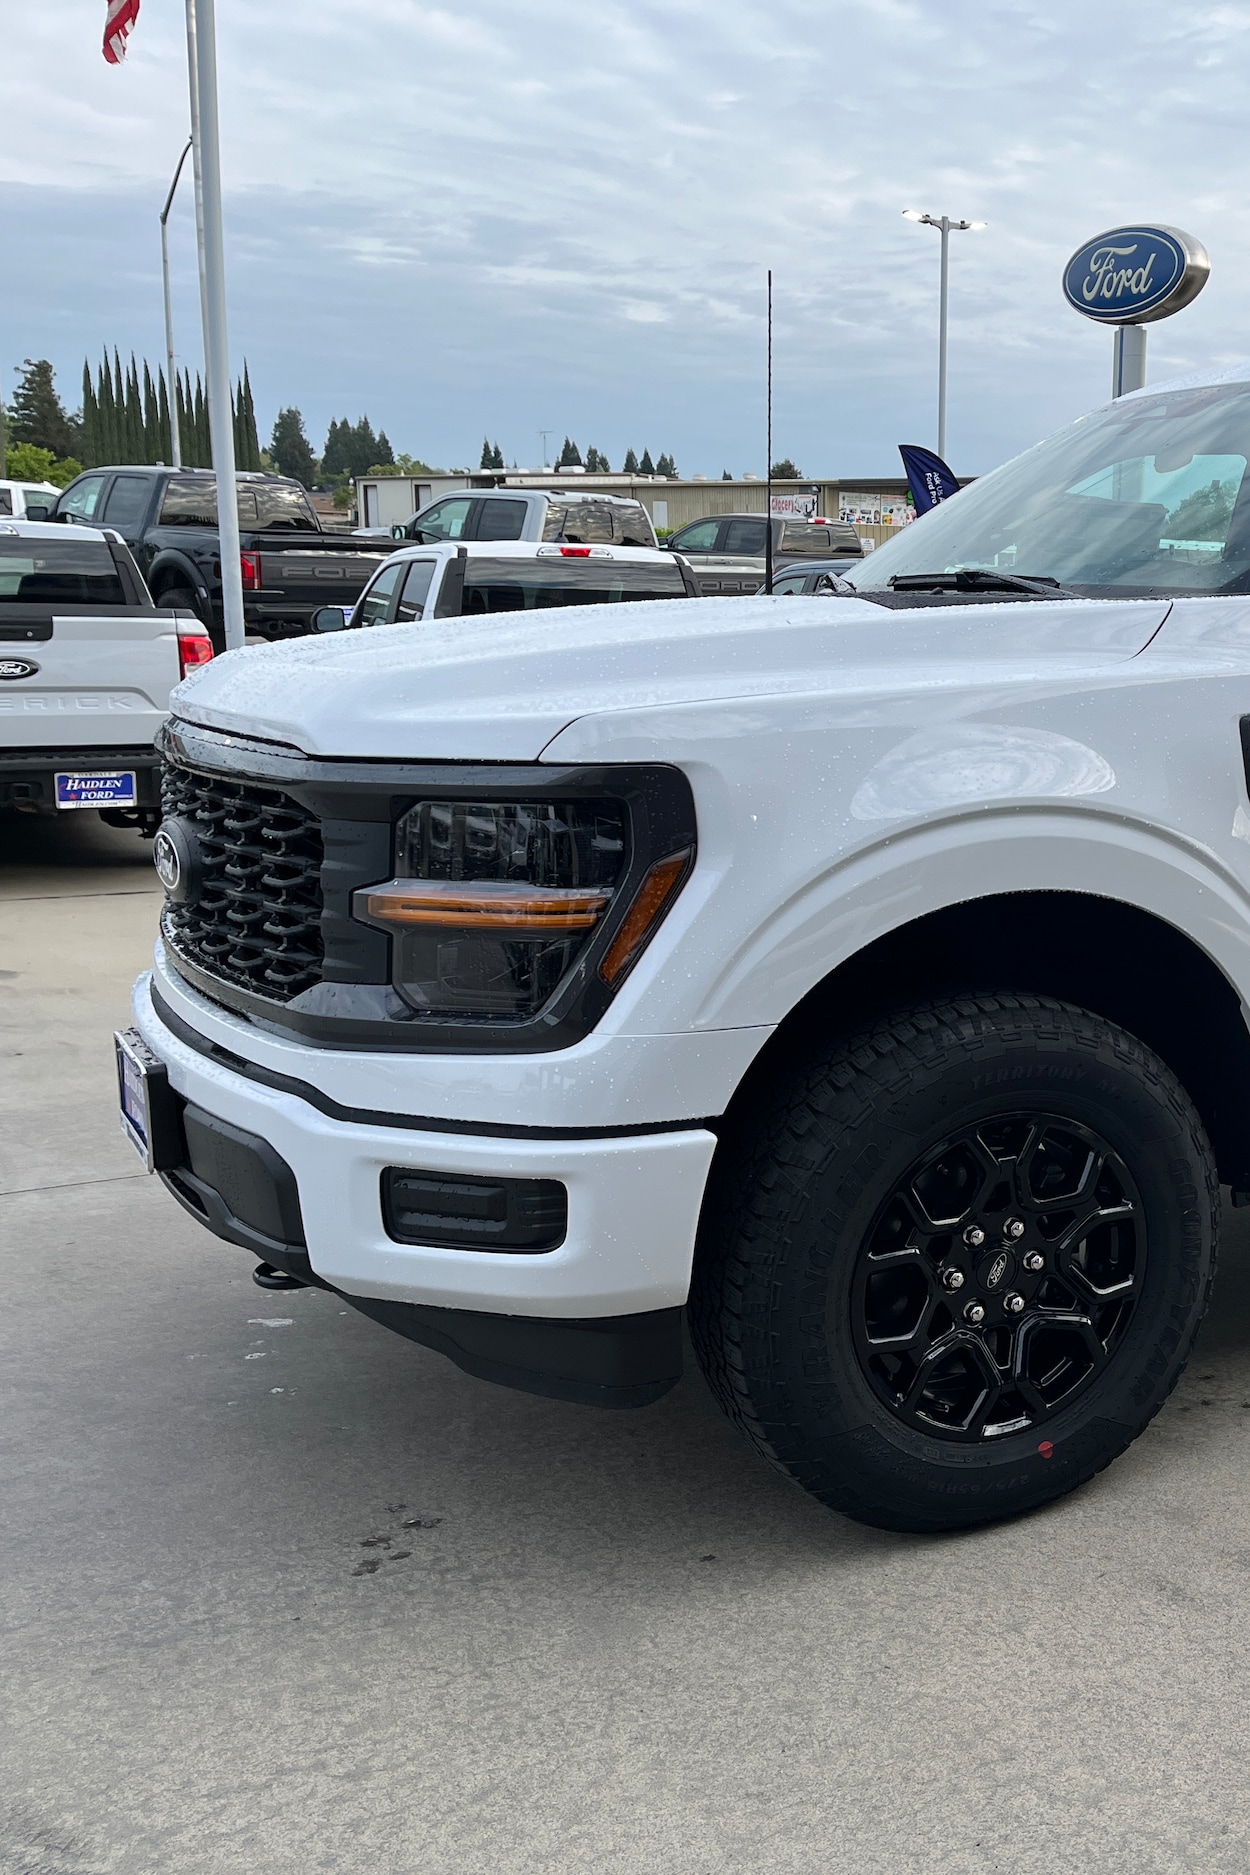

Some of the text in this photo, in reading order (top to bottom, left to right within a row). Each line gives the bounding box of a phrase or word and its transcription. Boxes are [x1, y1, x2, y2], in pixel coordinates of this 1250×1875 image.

[1082, 244, 1156, 301] Ford
[925, 473, 938, 504] Ford Pro
[281, 567, 371, 578] FOR
[700, 581, 760, 591] ORD
[66, 779, 122, 791] HAIDLEN
[80, 791, 114, 800] FORD
[156, 837, 174, 881] Ford
[970, 1064, 1087, 1091] TERRITORY
[798, 1142, 888, 1418] WRANGLER
[990, 1259, 1005, 1283] Ford
[1128, 1158, 1201, 1406] GOODYEAR
